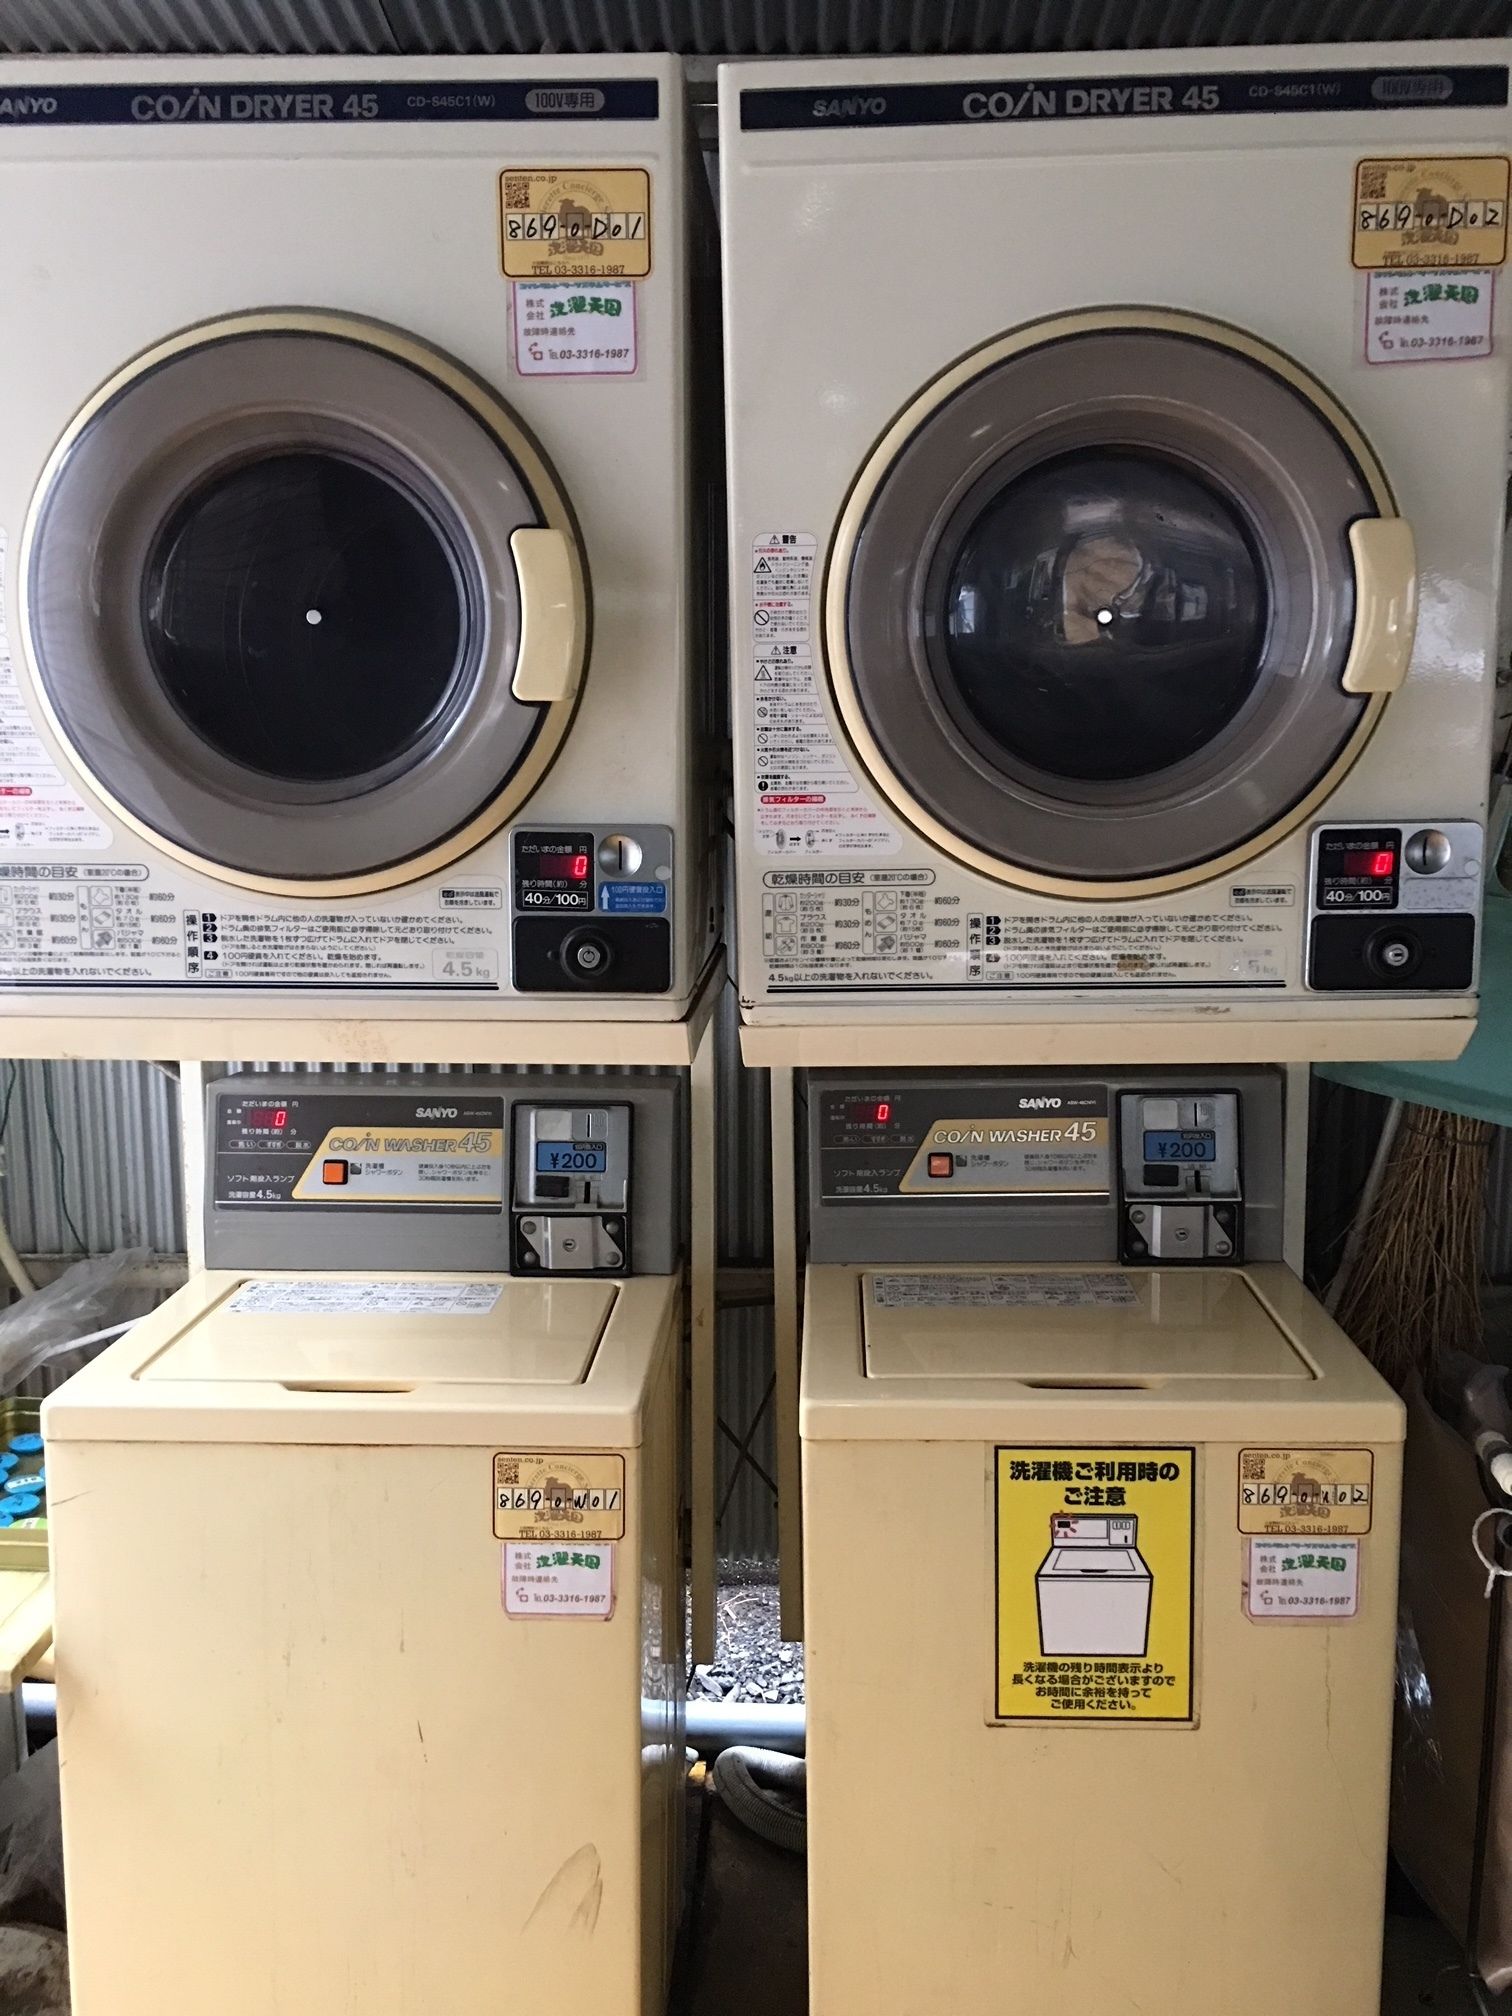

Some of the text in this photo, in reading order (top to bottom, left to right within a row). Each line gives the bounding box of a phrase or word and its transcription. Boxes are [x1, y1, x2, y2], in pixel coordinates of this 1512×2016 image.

[407, 94, 497, 109] CD-S45C1(W)
[533, 93, 597, 109] 100V専用
[1066, 86, 1172, 116] DRYER
[1180, 82, 1220, 110] 45
[230, 94, 334, 122] DRYER
[343, 93, 379, 119] 45
[812, 96, 887, 117] SANYO
[532, 264, 626, 275] TEL 03-3316-1987
[560, 348, 630, 361] 03-3316-1987
[783, 646, 797, 655] 注意
[574, 855, 588, 876] 0
[1375, 853, 1390, 873] 0
[771, 872, 865, 886] 乾燥時間の目安
[476, 967, 491, 979] kg
[1018, 1097, 1062, 1110] SANYO
[274, 1111, 286, 1126] 0
[415, 1107, 458, 1119] SANYO
[877, 1104, 889, 1120] 0
[989, 1129, 1062, 1143] WASHER
[1064, 1121, 1097, 1142] 45
[384, 1137, 457, 1153] WASHER
[458, 1131, 492, 1153] 45
[1158, 1142, 1206, 1158] ¥200
[550, 1152, 597, 1169] ¥200
[1009, 1460, 1180, 1482] 洗濯機ご利用時の
[1064, 1485, 1127, 1507] ご注意
[539, 1530, 602, 1538] 03-3316-1987
[1264, 1524, 1349, 1533] TEL 03-3316-1987
[543, 1595, 606, 1603] 03-3316-1987
[1287, 1596, 1352, 1605] 03-3316-1987
[1023, 1661, 1164, 1674] 洗濯機の残り時間表示より
[1012, 1674, 1176, 1687] 長くなる場合がございますので
[1035, 1687, 1152, 1698] お時間に余裕を持って
[1050, 1698, 1137, 1711] ご使用ください。
